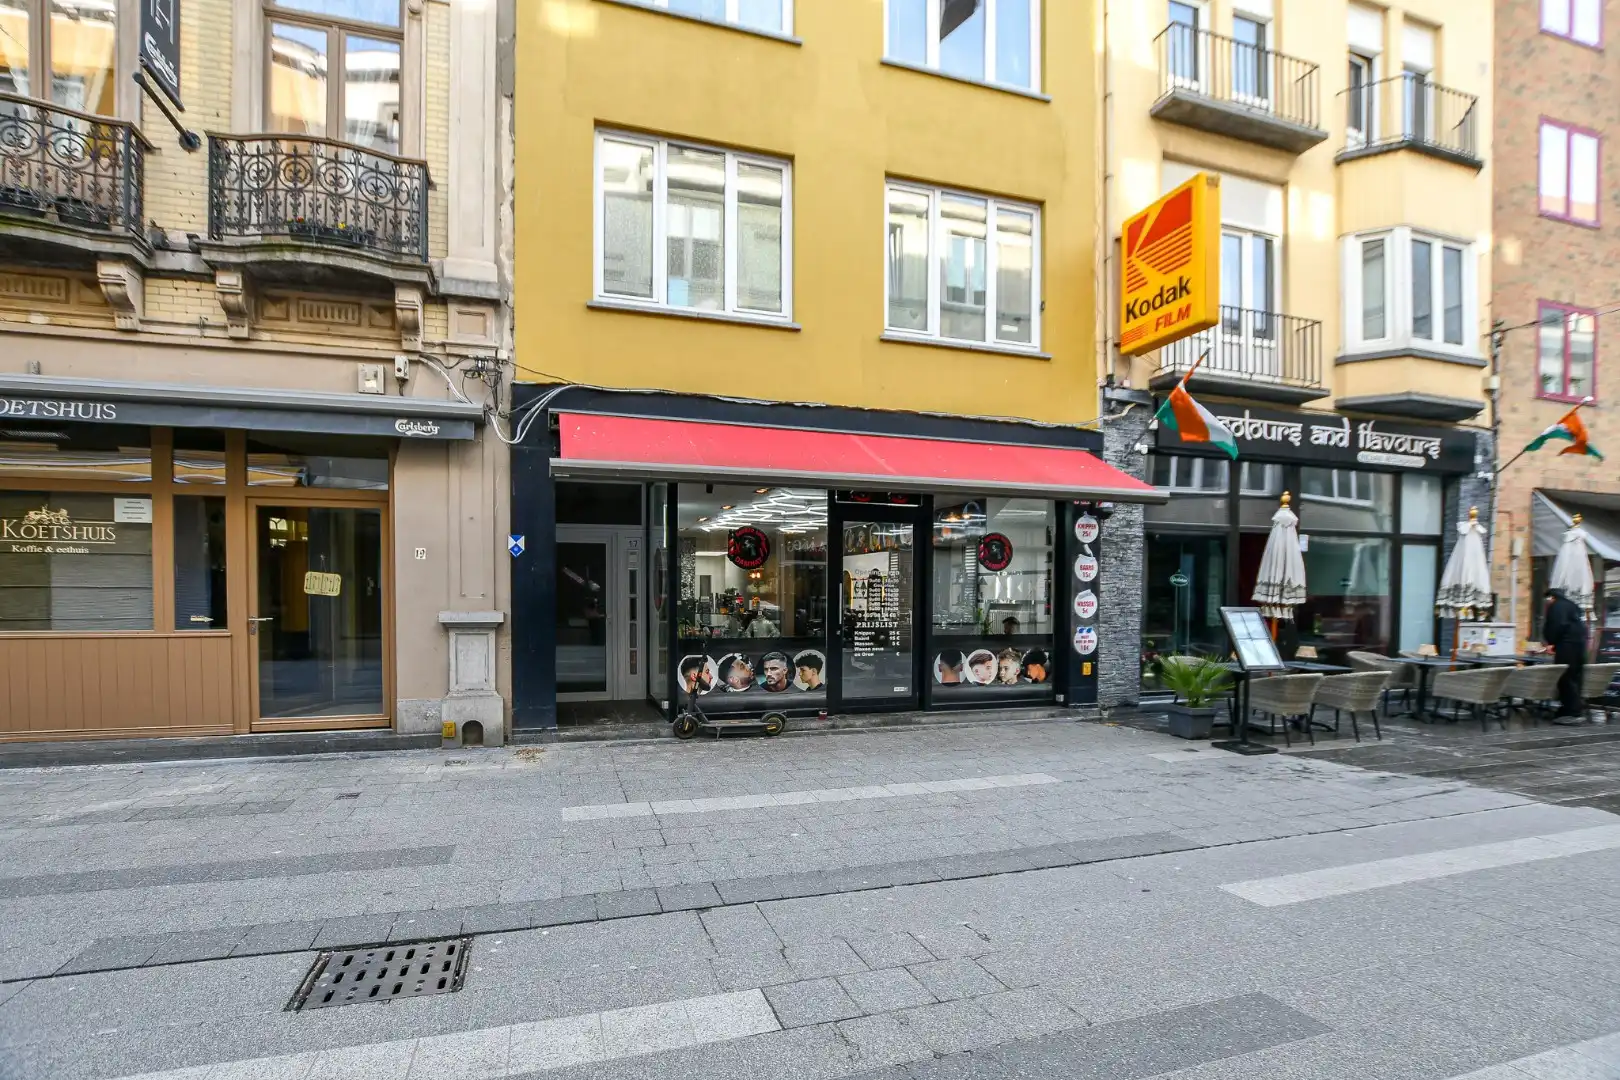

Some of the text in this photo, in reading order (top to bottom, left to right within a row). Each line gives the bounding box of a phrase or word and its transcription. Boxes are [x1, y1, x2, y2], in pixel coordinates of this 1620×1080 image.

[1125, 276, 1192, 324] Kodak
[1154, 303, 1192, 332] FILM
[394, 418, 441, 437] Carlsberg
[1310, 416, 1351, 449] and
[1357, 419, 1442, 460] flavours
[11, 544, 90, 554] Koffie & eethuis
